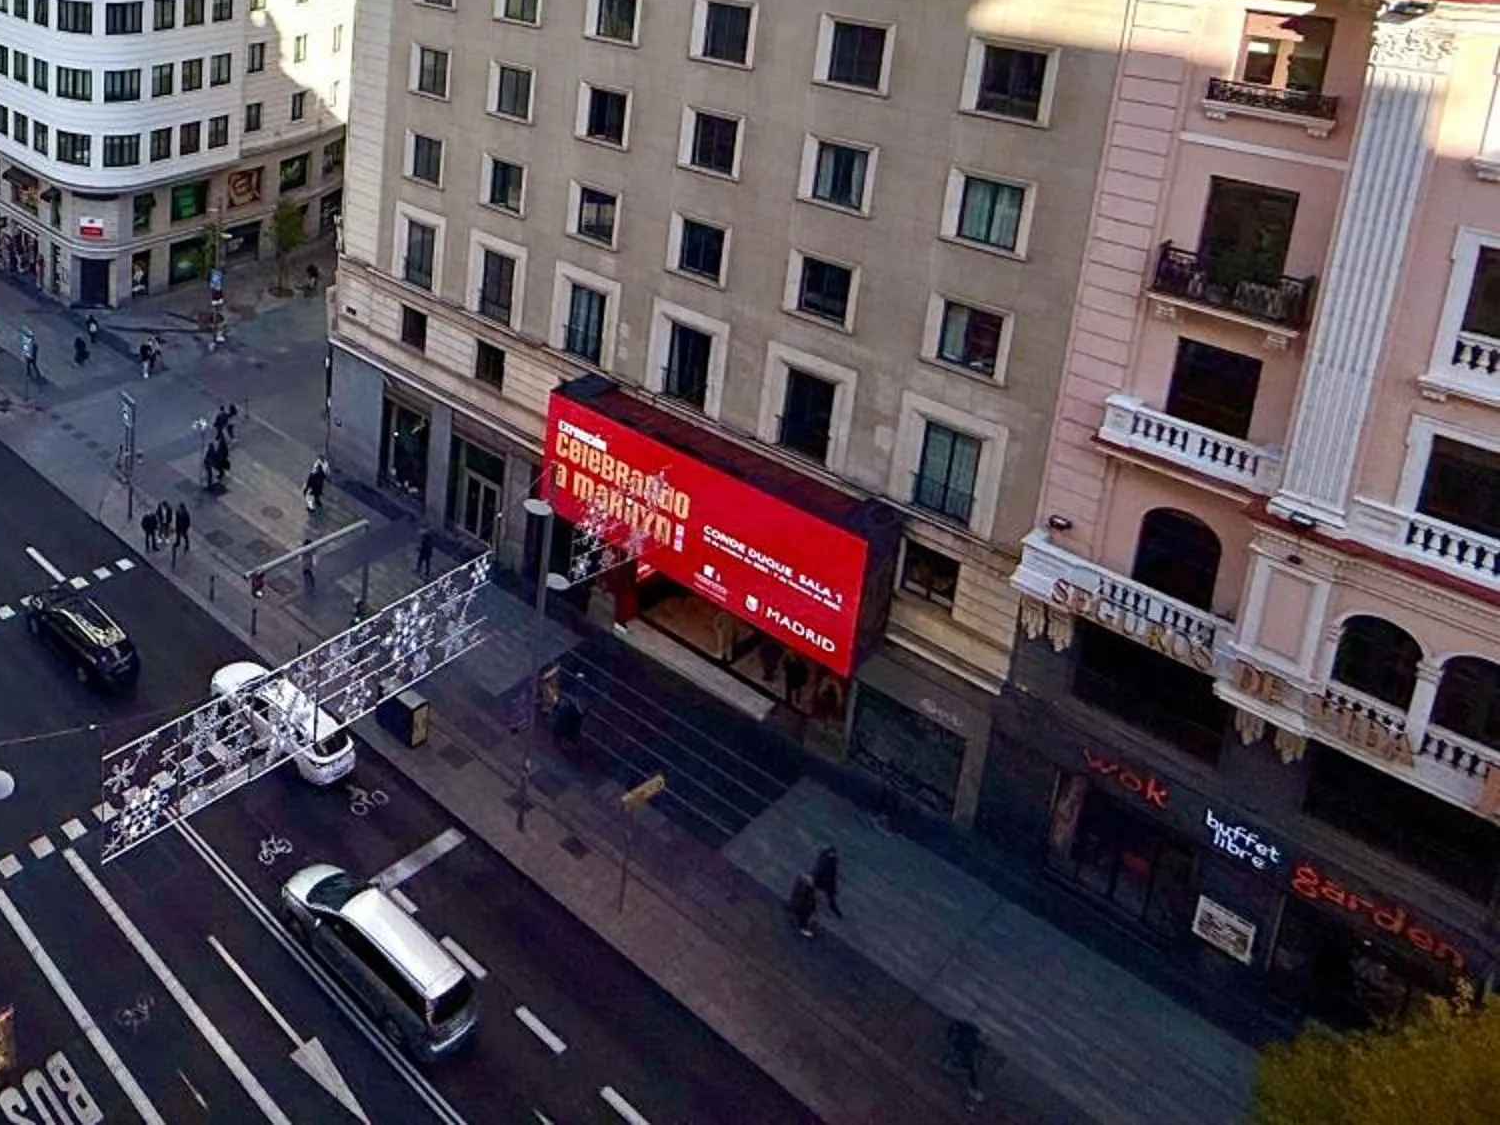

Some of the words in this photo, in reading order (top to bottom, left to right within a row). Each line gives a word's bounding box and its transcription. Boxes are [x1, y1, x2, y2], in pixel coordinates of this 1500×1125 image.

[703, 525, 747, 554] CONDE
[747, 548, 794, 578] DUQUE
[799, 574, 832, 599] SALA
[765, 606, 836, 653] MADRID
[1083, 746, 1169, 810] wok
[1206, 808, 1282, 865] buffet
[1213, 830, 1267, 871] libre
